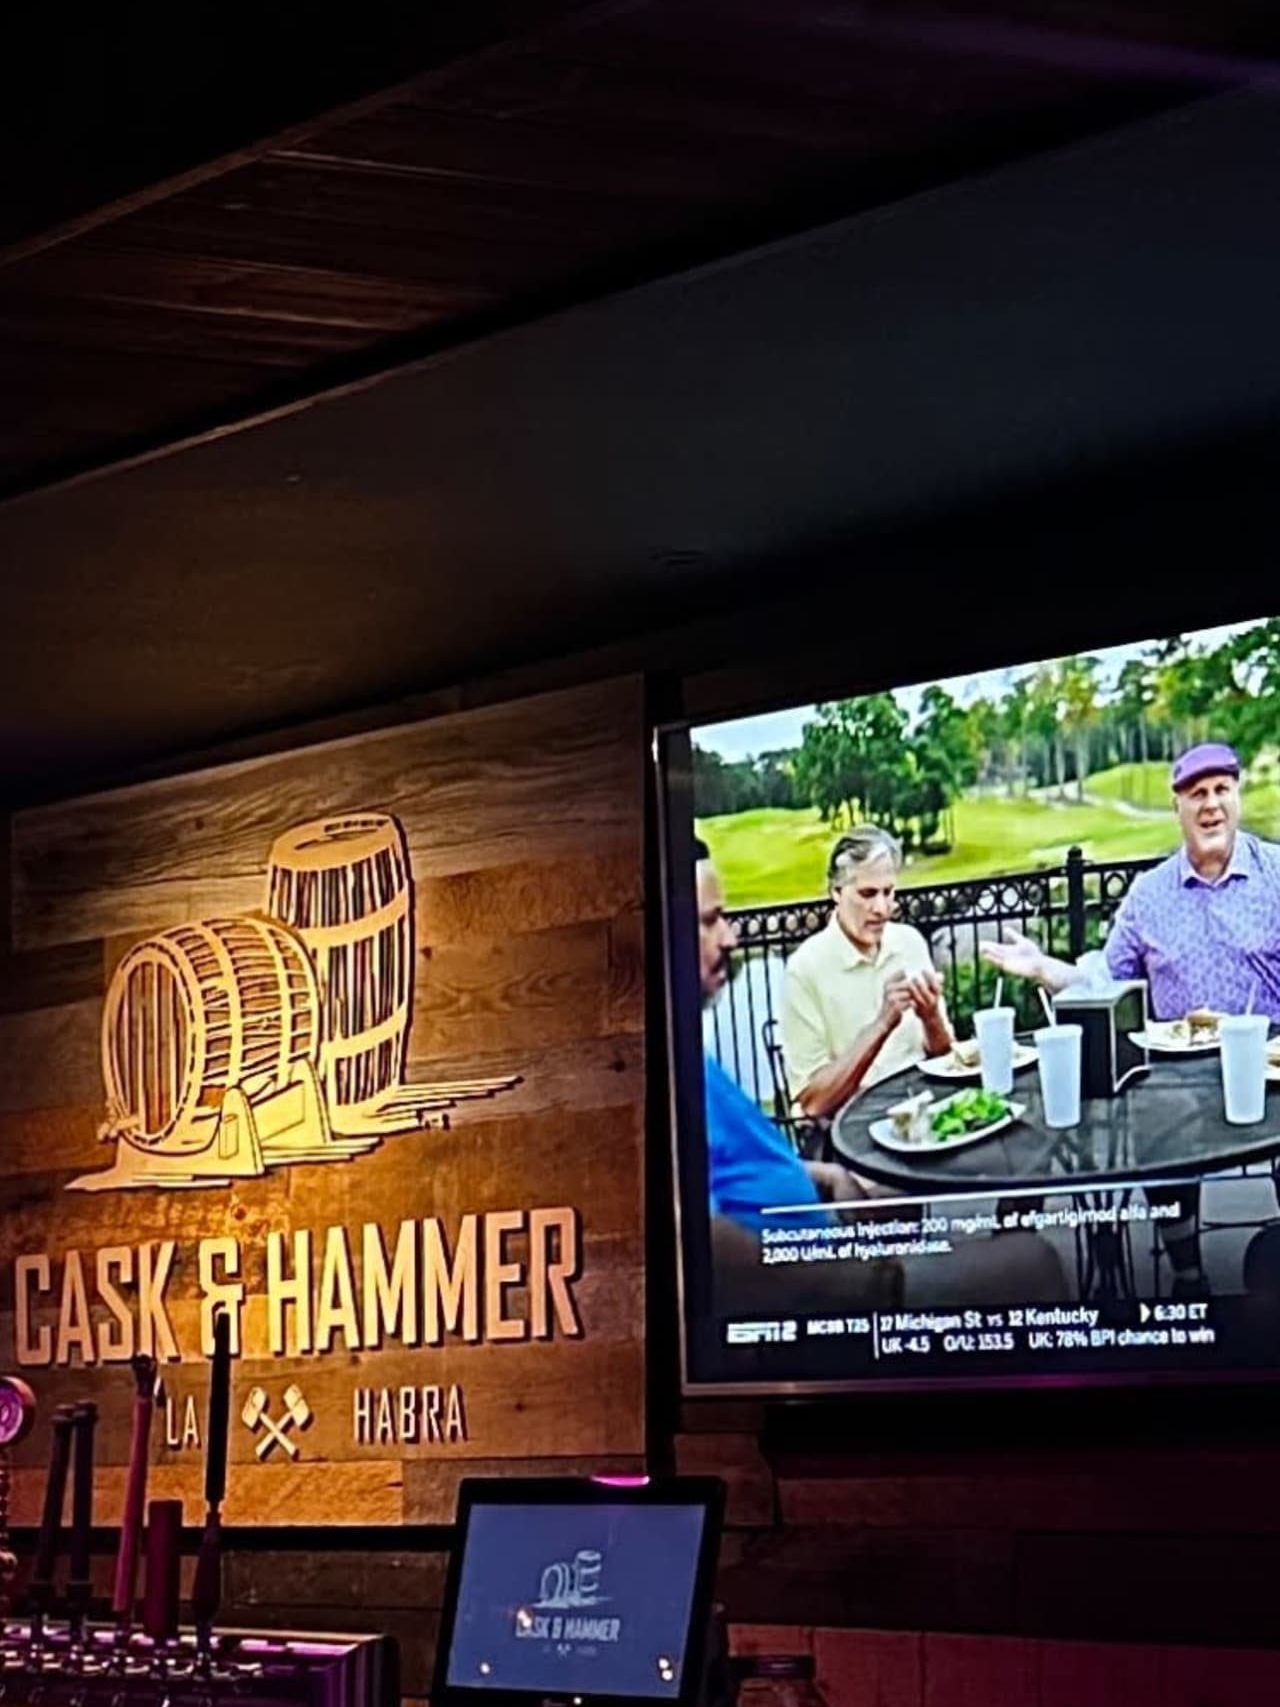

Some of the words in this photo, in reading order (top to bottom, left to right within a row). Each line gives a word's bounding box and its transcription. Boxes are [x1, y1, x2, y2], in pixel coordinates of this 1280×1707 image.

[761, 1224, 855, 1244] Subcutaneous
[921, 1217, 948, 1233] 200
[1003, 1212, 1019, 1228] of
[1149, 1201, 1181, 1219] and
[14, 1241, 180, 1366] CASK
[199, 1237, 243, 1356] &
[266, 1207, 582, 1355] HAMMER
[727, 1321, 797, 1343] ESPN2
[895, 1313, 962, 1334] Michigan
[964, 1310, 982, 1328] St
[987, 1314, 1003, 1327] vs
[1008, 1310, 1023, 1327] 12
[1025, 1306, 1099, 1328] Kentucky
[1154, 1303, 1186, 1321] 6:30
[1188, 1302, 1208, 1320] ET
[881, 1337, 903, 1354] UK
[1056, 1330, 1088, 1348] 78%
[1117, 1328, 1169, 1346] chance
[1171, 1326, 1187, 1344] to
[1188, 1324, 1215, 1343] win
[165, 1398, 199, 1447] LA
[354, 1385, 468, 1445] HABRA
[564, 1617, 621, 1642] HAMMER
